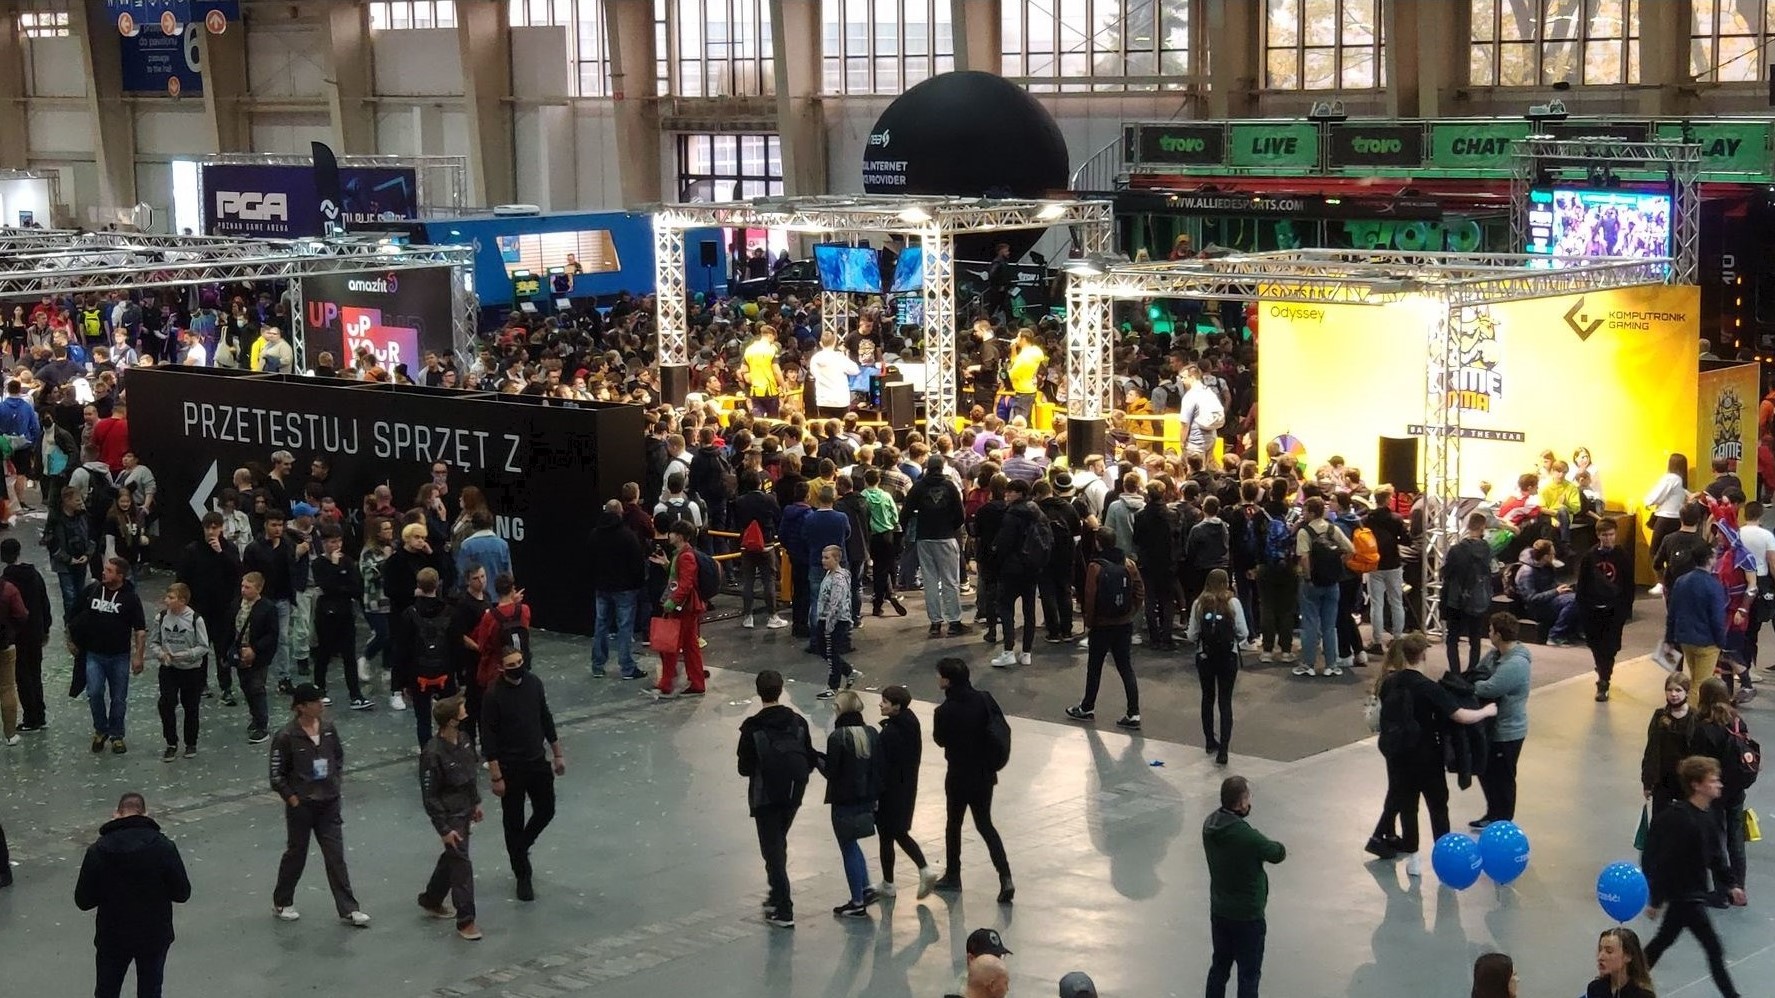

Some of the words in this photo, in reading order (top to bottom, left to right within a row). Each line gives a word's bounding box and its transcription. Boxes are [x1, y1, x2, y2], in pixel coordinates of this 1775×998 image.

[184, 22, 202, 73] 6
[1252, 137, 1298, 155] LIVE
[1452, 137, 1510, 155] CHAT
[216, 191, 288, 221] PGA
[1165, 197, 1304, 211] WWW.ALLIEDESPORTS.COM
[348, 277, 387, 293] amazfit
[309, 301, 338, 328] UP
[1271, 305, 1325, 324] Odyssey
[1608, 311, 1686, 322] KOMPUTRONIK
[1608, 321, 1650, 331] GAMING
[183, 401, 359, 455] PRZETESTUJ
[373, 421, 489, 473] SPRZĘT
[503, 434, 522, 473] Z
[1471, 430, 1490, 439] THE
[1496, 432, 1522, 441] YEAR
